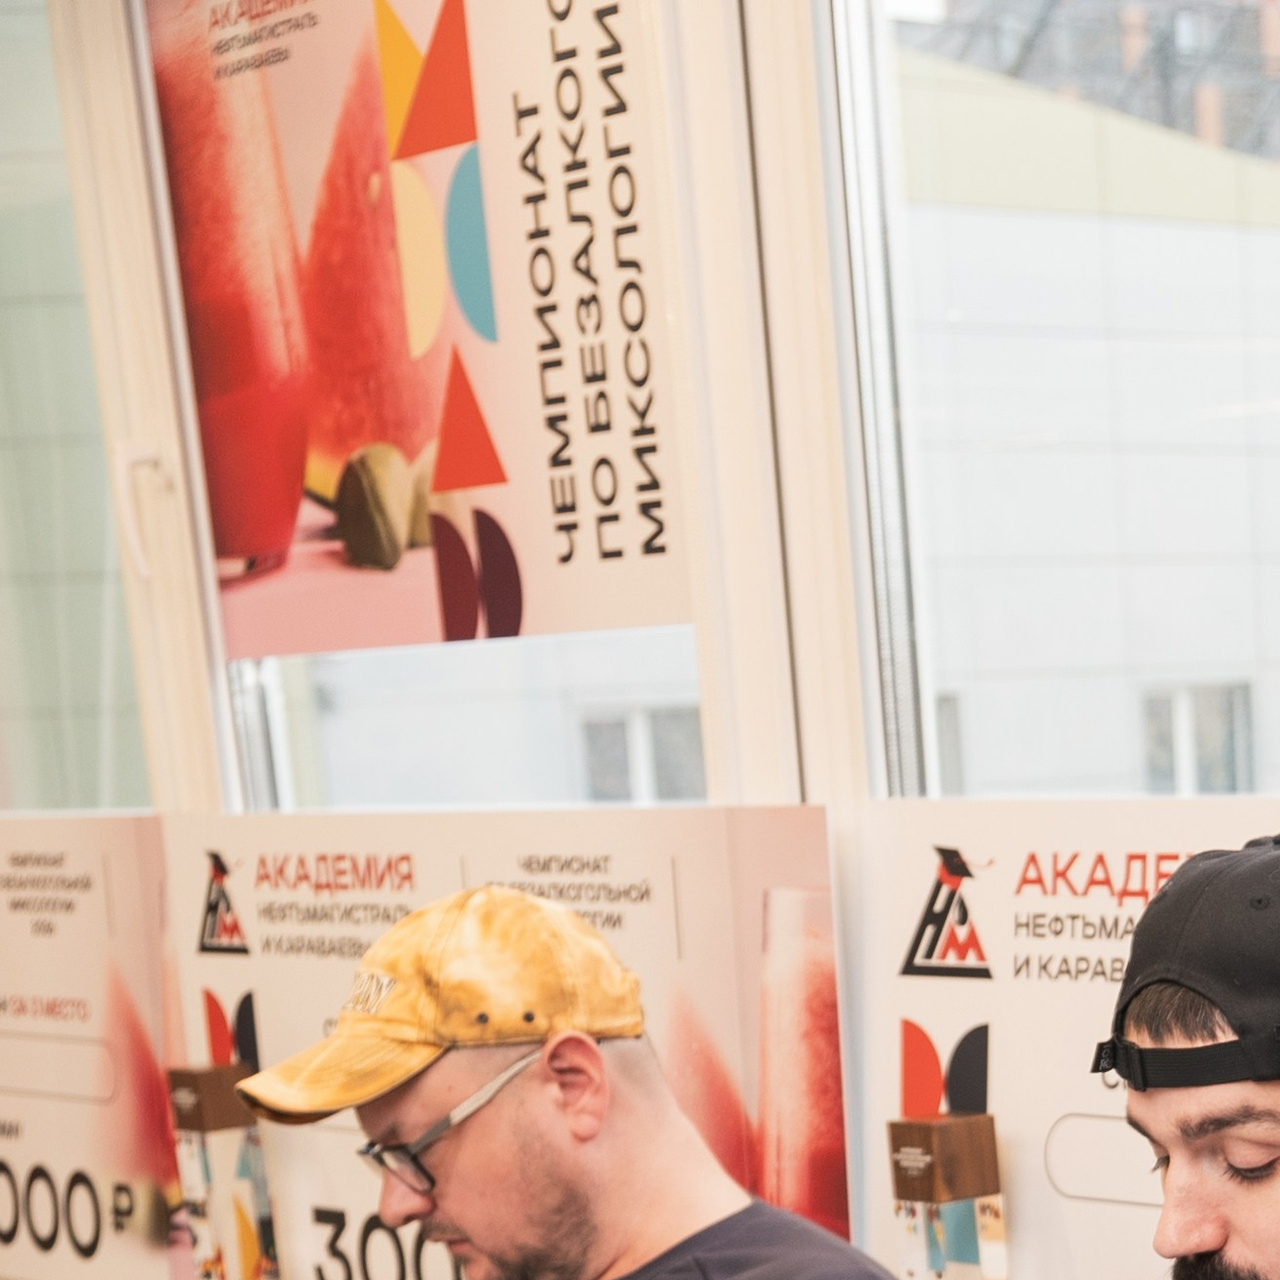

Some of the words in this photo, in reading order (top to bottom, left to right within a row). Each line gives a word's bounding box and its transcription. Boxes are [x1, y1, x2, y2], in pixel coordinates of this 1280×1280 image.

[594, 4, 667, 556] МИКСОЛОГИИ
[512, 91, 579, 564] ЧЕМПИОНАТ
[592, 457, 624, 559] ПО
[254, 852, 415, 897] АКАДЕМИЯ
[1013, 851, 1194, 908] АКАДЕ
[1013, 911, 1137, 941] НЕФТЬМА
[1013, 955, 1030, 979] И
[1037, 955, 1126, 983] КАРАВ
